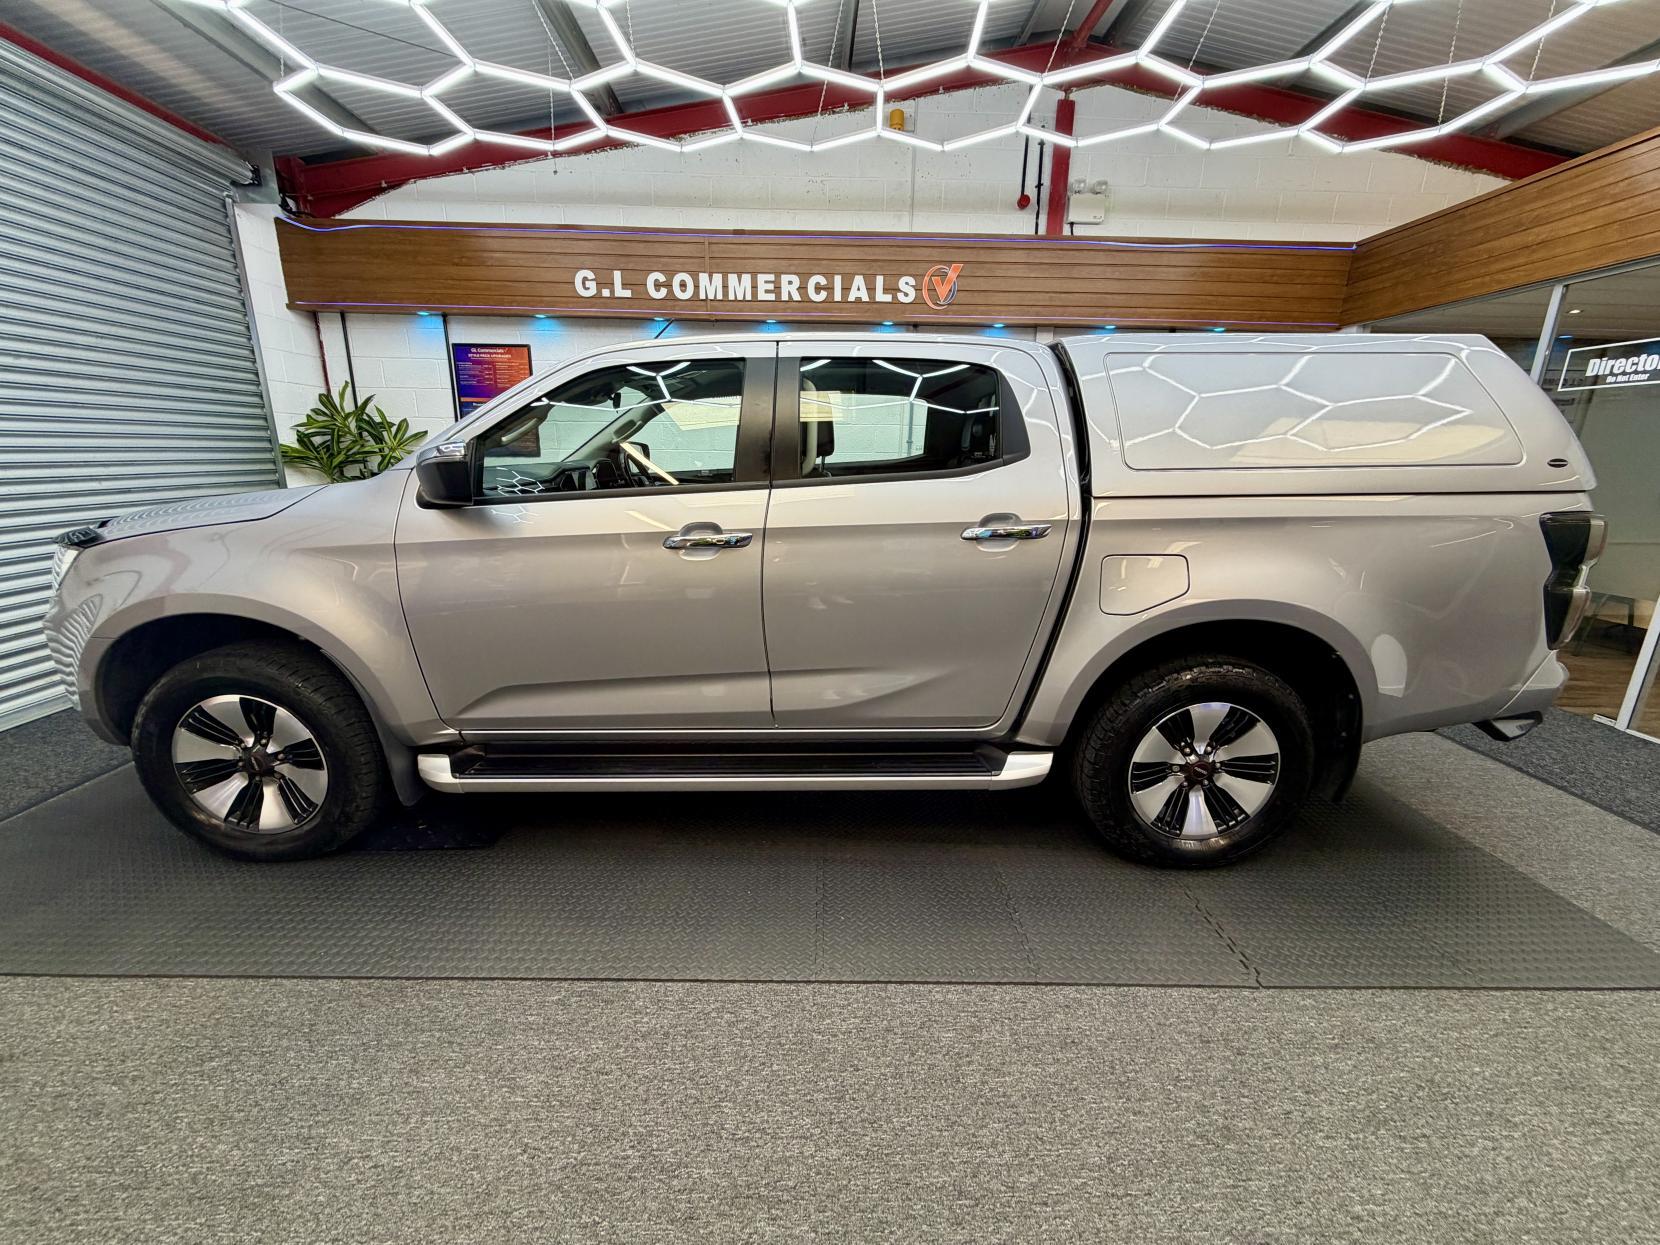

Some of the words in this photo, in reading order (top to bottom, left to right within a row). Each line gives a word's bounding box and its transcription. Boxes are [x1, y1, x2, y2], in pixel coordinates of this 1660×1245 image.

[574, 269, 632, 299] G.L
[646, 271, 916, 304] COMMERCIALS
[1585, 354, 1660, 376] Directo
[1616, 375, 1629, 383] Not
